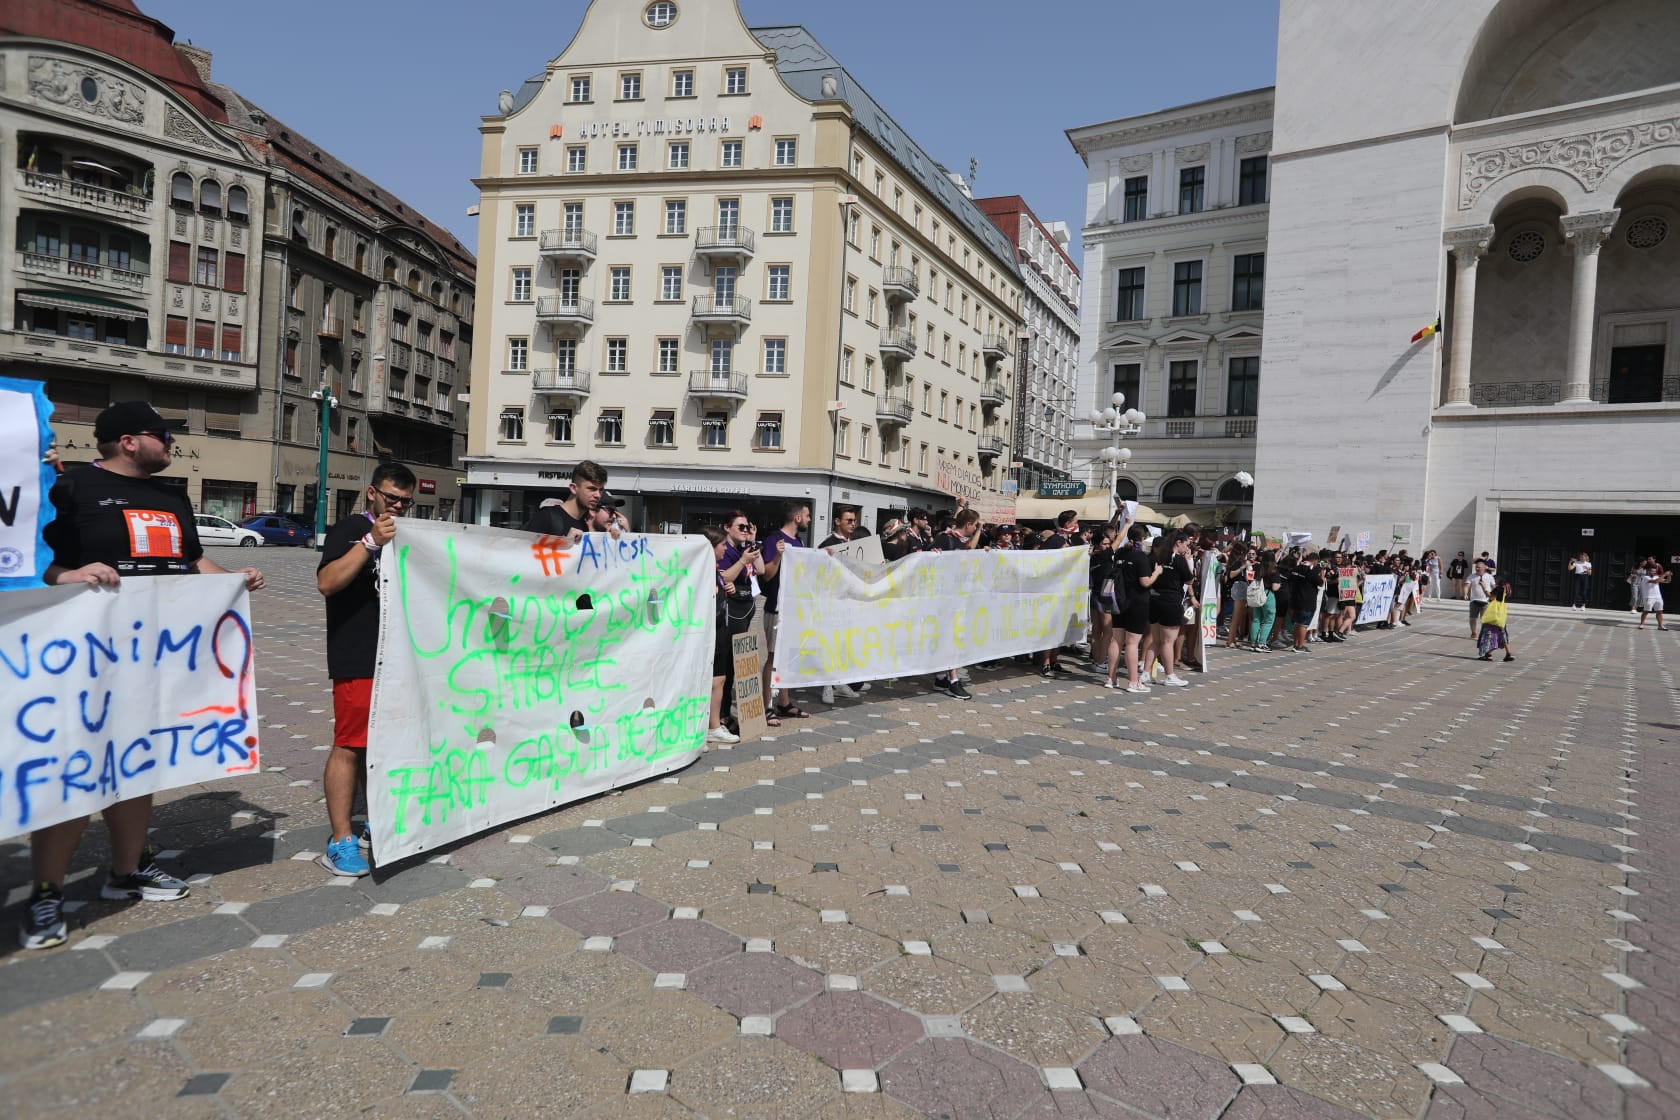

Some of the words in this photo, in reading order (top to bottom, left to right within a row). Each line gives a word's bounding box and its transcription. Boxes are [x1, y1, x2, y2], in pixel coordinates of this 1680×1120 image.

[580, 119, 630, 139] HOTEL
[636, 115, 730, 137] TIMISOARA
[538, 471, 573, 480] FIRSTBAN
[936, 471, 950, 491] NU
[719, 486, 751, 495] COFFEE
[447, 634, 628, 715] STABILE
[16, 689, 111, 743] CU
